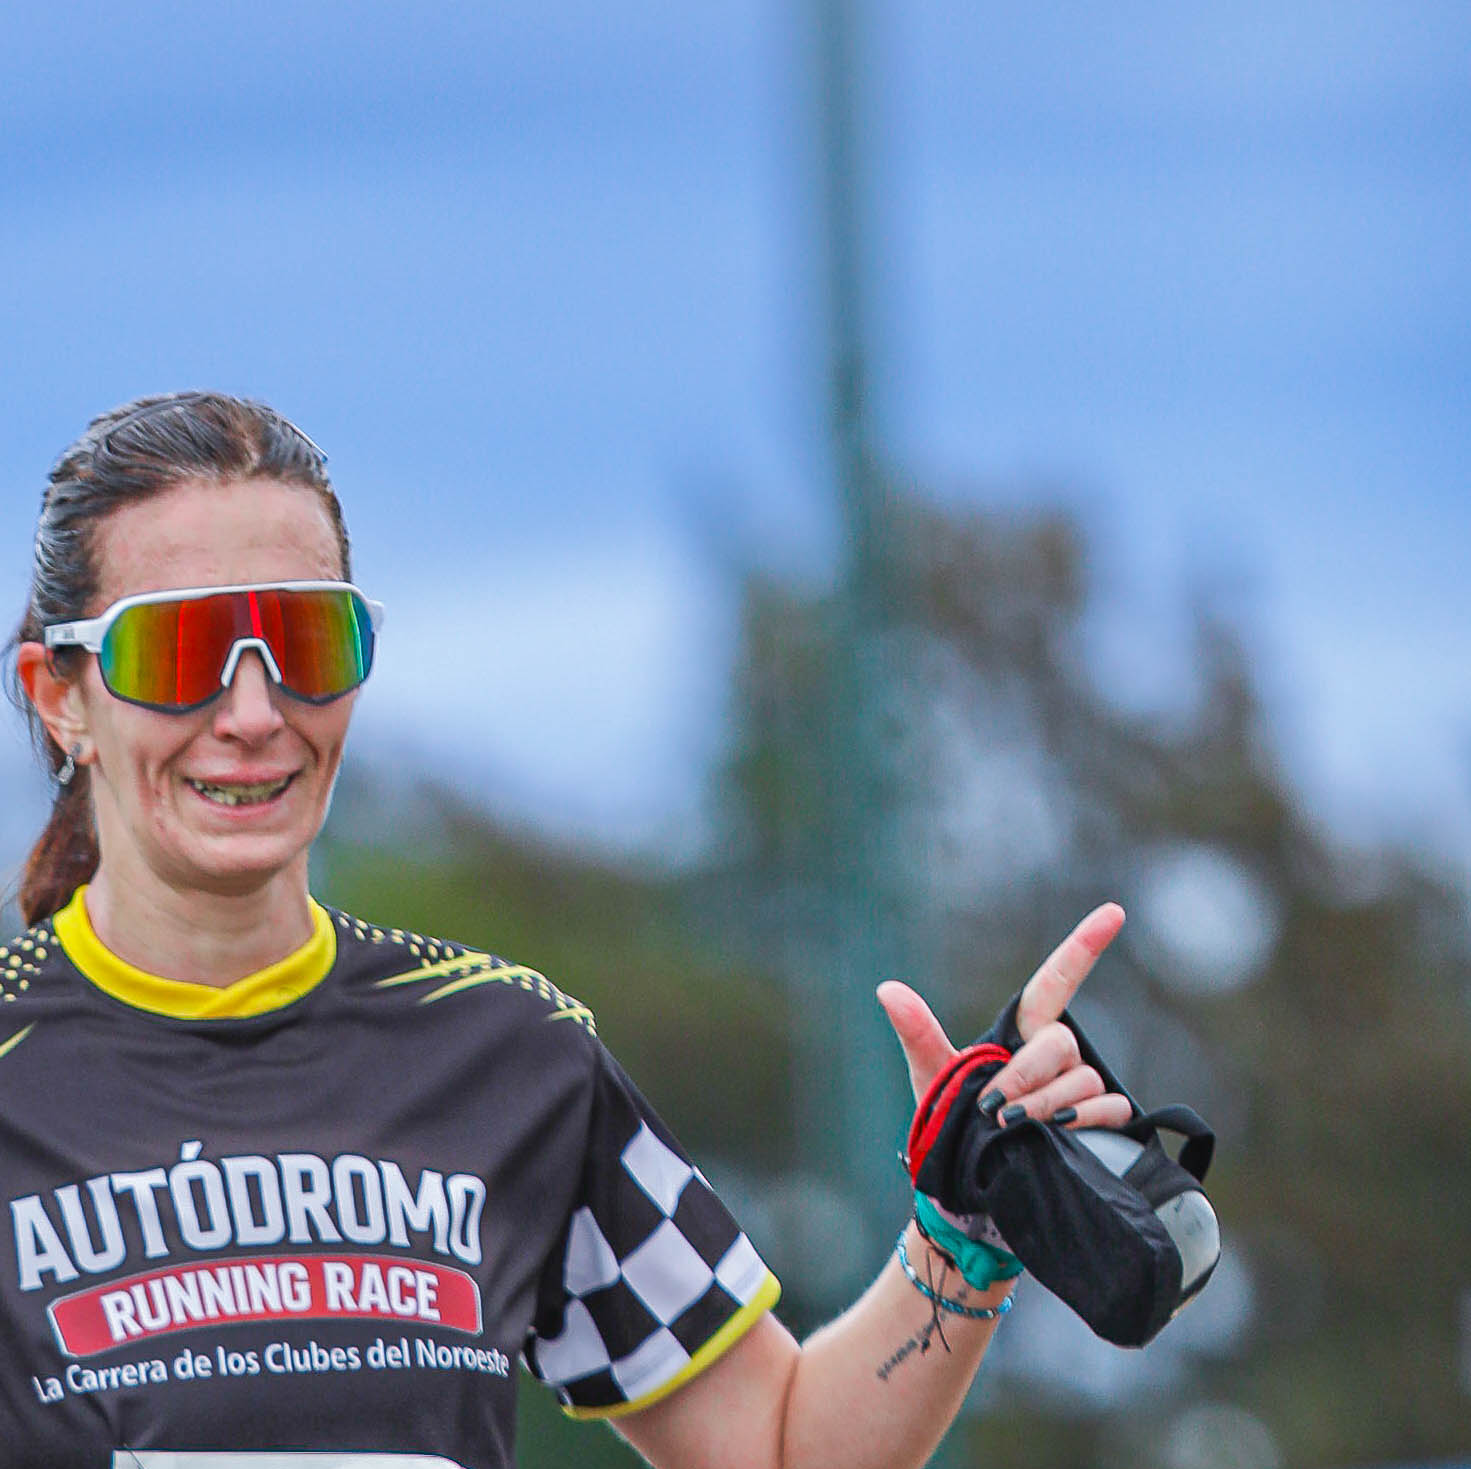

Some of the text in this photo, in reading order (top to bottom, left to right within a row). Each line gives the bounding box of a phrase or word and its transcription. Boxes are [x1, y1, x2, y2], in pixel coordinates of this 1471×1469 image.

[9, 1140, 486, 1290] AUTÓDROMO
[99, 1262, 440, 1342] RUNNING RACE
[33, 1337, 510, 1403] La Carrera de los Clubes del Noroeste
